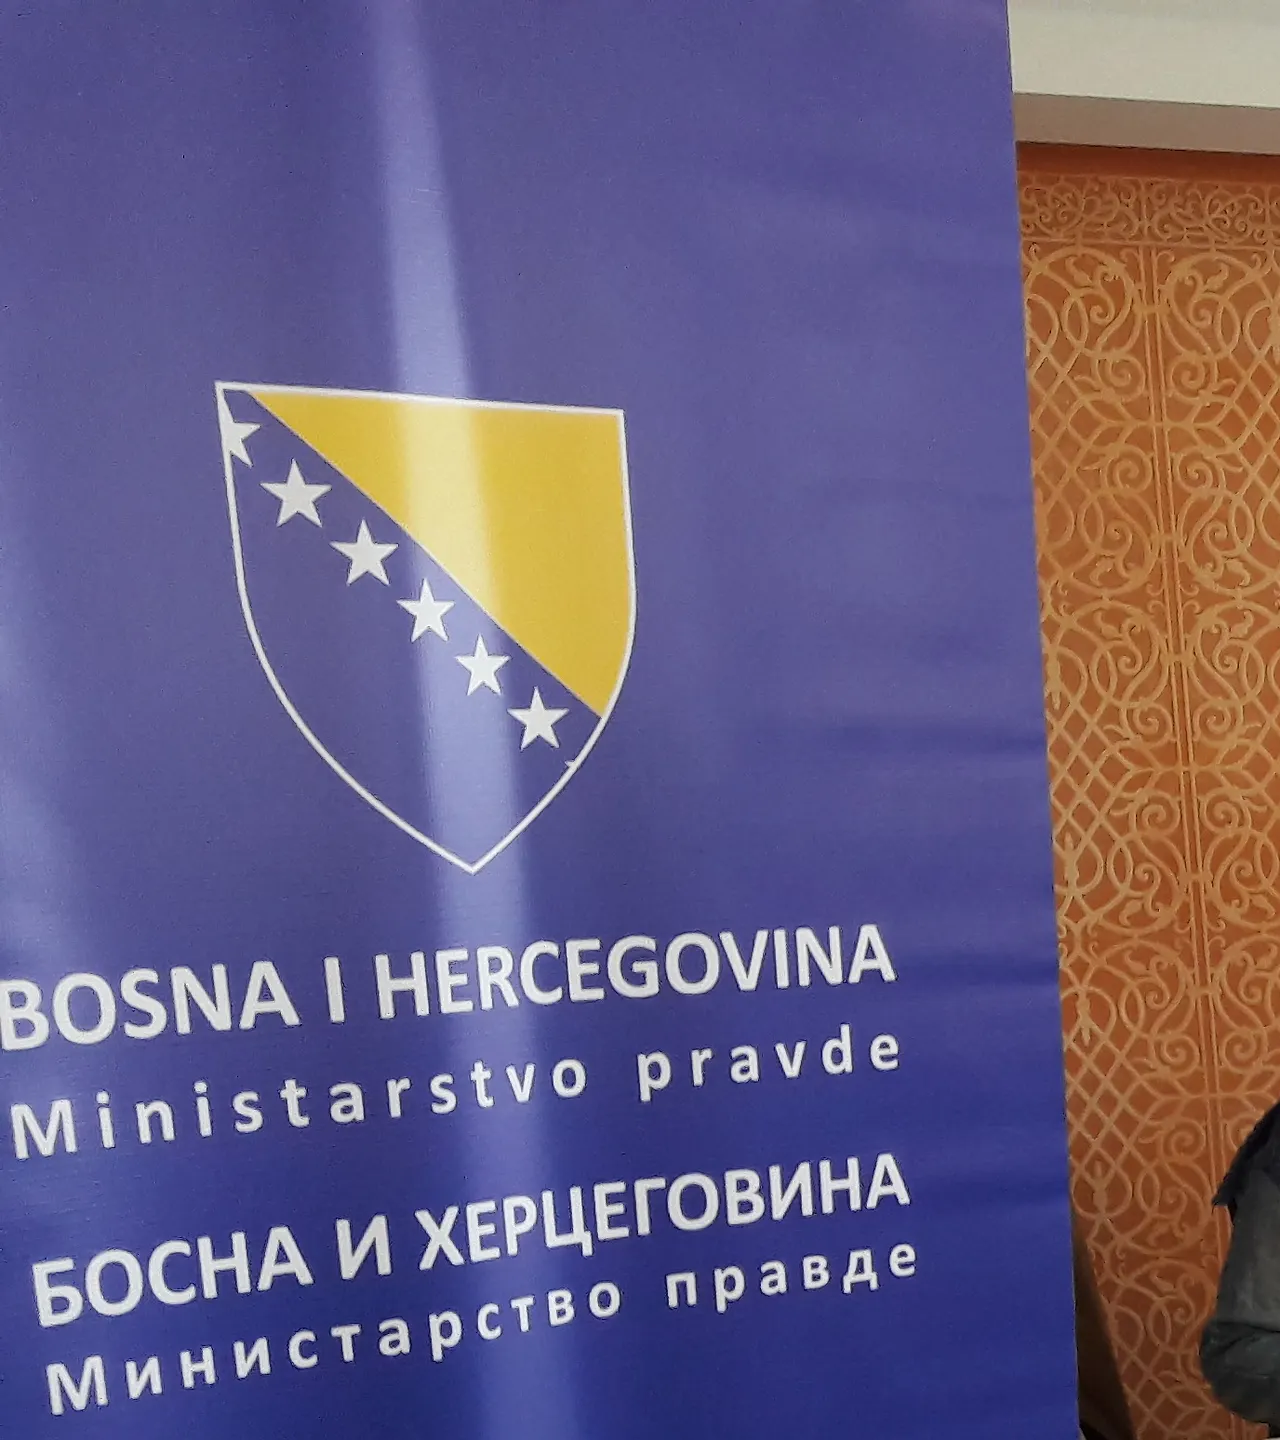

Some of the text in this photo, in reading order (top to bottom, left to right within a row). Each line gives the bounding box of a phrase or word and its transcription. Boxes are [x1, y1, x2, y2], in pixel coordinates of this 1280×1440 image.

[0, 924, 895, 1050] BOSNA I HERCEGOVINA
[11, 1024, 898, 1159] Ministarstvo pravde
[32, 1153, 910, 1328] БОСНА И ХЕРЦЕГОВИНА
[46, 1244, 916, 1415] Министарство правде
